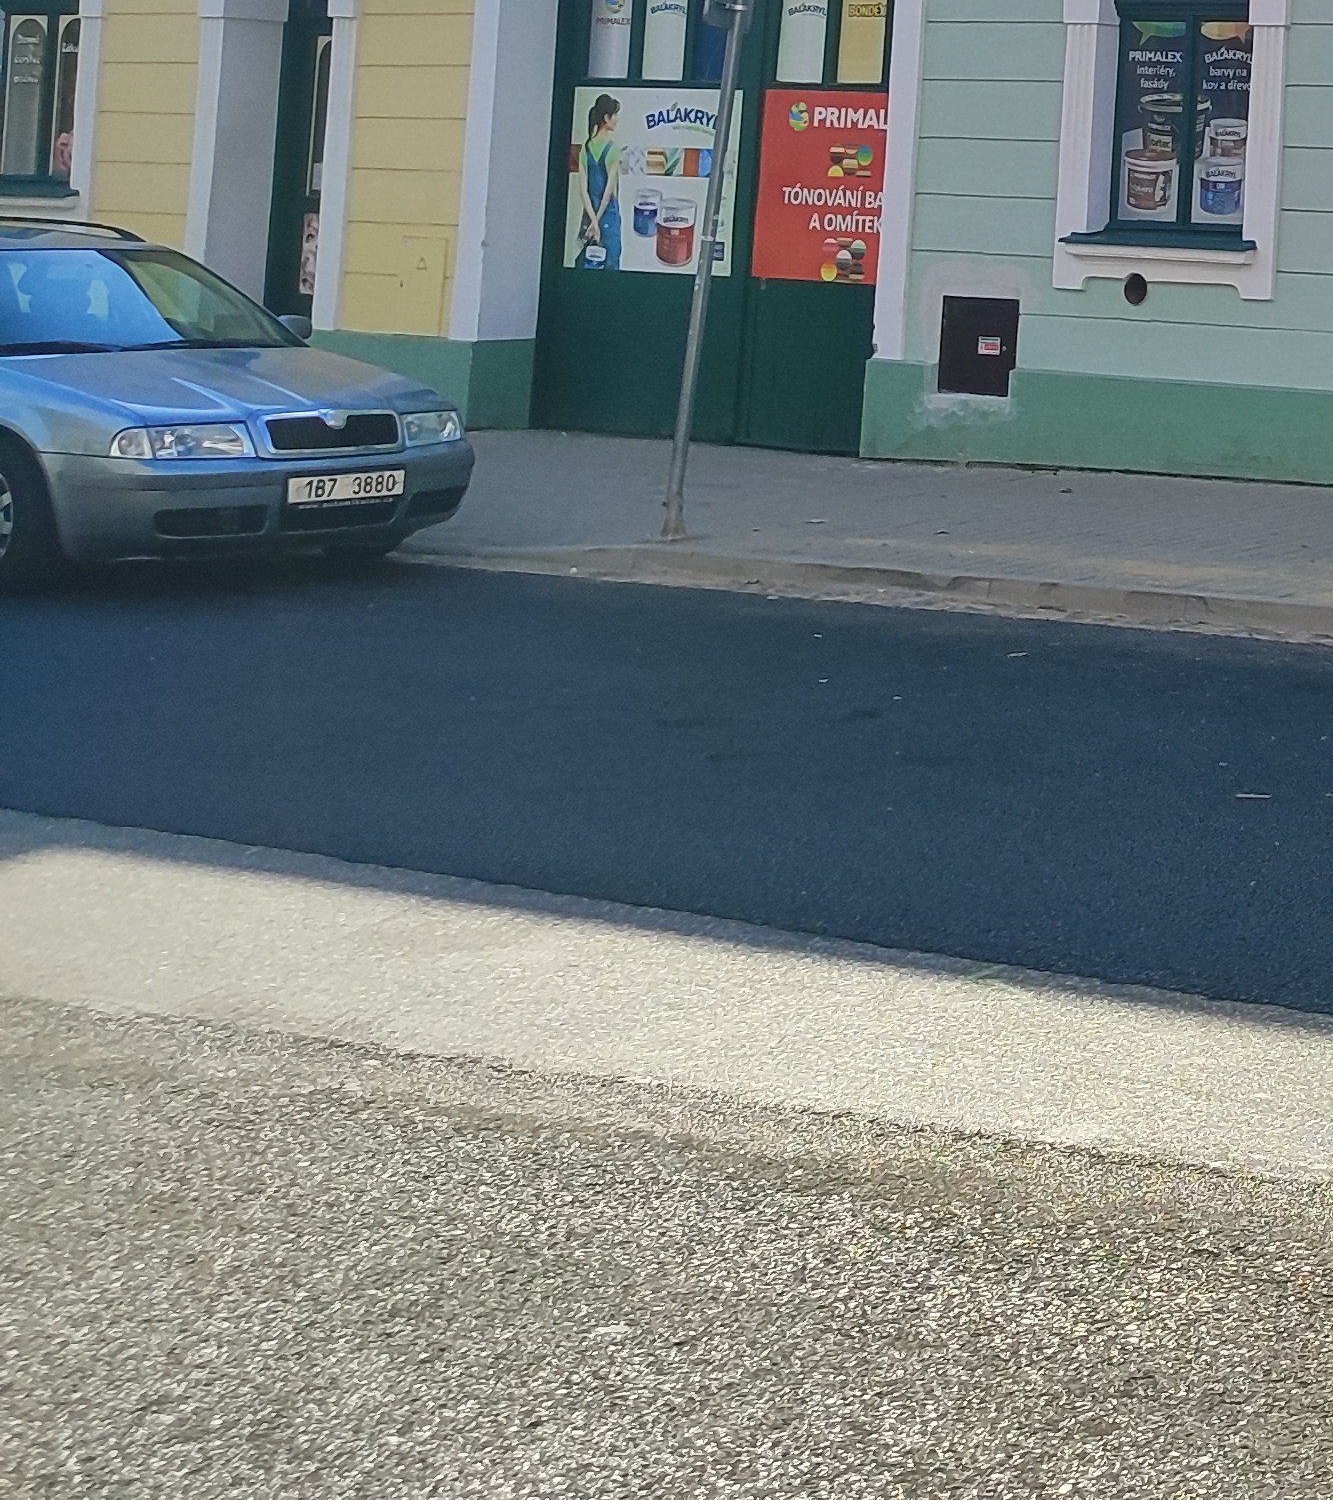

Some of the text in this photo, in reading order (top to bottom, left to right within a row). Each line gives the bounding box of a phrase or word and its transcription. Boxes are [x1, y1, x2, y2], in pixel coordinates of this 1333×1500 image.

[1128, 50, 1183, 63] PRIMALEX
[1209, 66, 1248, 79] barvy na
[1140, 78, 1170, 90] fasády
[1202, 79, 1219, 90] kov
[1219, 80, 1226, 90] a
[813, 106, 888, 130] PRIMAL
[782, 182, 884, 209] TÓNOVÁNÍ BA
[808, 212, 821, 231] A
[304, 473, 397, 499] 1B7 3880
